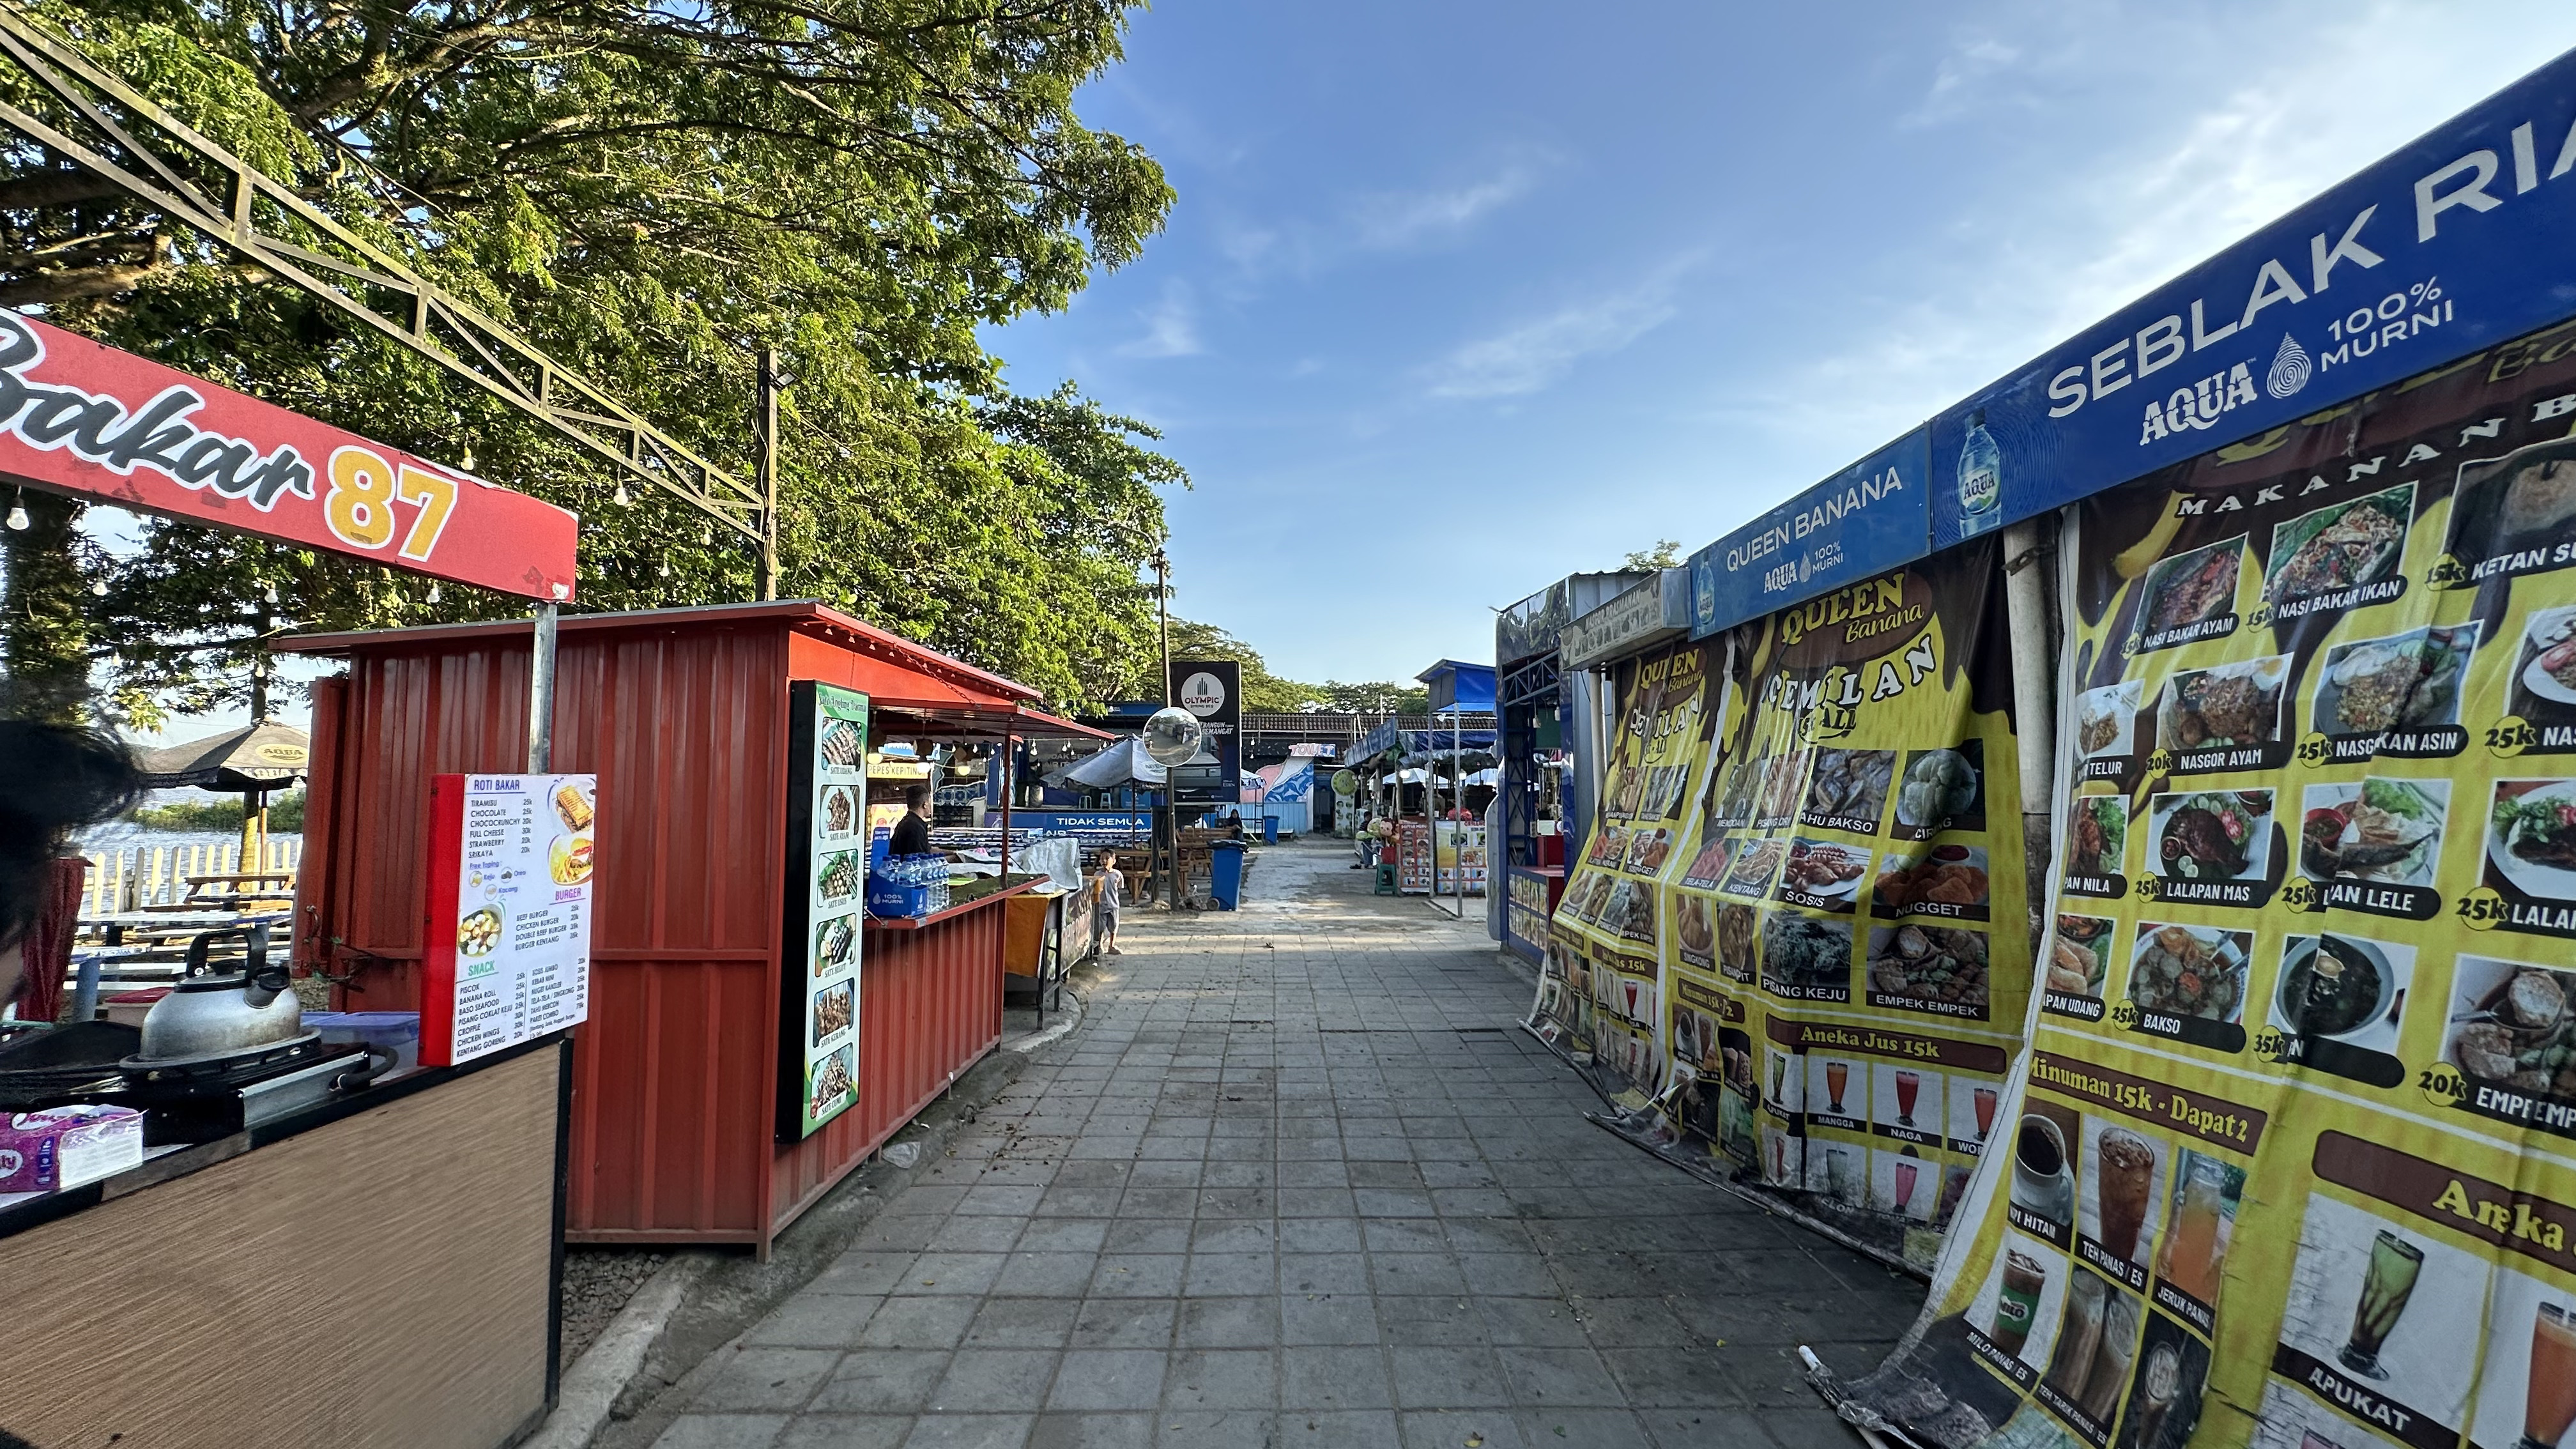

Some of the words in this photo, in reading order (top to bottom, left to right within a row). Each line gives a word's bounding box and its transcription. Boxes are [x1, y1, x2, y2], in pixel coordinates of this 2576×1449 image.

[2047, 203, 2385, 418] SEBLAK
[2414, 117, 2576, 243] RI
[2327, 275, 2442, 342] 100%
[2321, 300, 2454, 372] MURNI
[2139, 362, 2258, 446] AQUA
[2177, 417, 2506, 516] MAKANAN
[1963, 471, 1995, 500] AQUA
[324, 445, 459, 562] 87
[1727, 521, 1790, 572] QUEEN
[1795, 466, 1903, 540] BANANA
[1814, 541, 1841, 561] 100%
[1812, 554, 1843, 574] MURNI
[2426, 563, 2465, 583] 15k
[2471, 548, 2547, 580] KETAN
[1763, 560, 1798, 594] AQUA
[1698, 597, 1714, 612] AQUA
[1781, 573, 1905, 644] QUEEN
[2247, 609, 2274, 626] 15k
[2279, 602, 2308, 619] NASI
[2312, 588, 2359, 611] BAKAR
[2361, 580, 2400, 601] IKAN
[1846, 602, 1924, 643] Banana
[2143, 632, 2166, 648] NASI
[2166, 626, 2200, 645] BAKAR
[2200, 617, 2234, 637] AYAM
[2297, 739, 2333, 760] 25k
[2419, 733, 2457, 752] ASIN
[2485, 724, 2536, 749] 25k
[1288, 744, 1334, 756] TOILET
[2146, 755, 2172, 771] 20k
[2181, 753, 2224, 770] NASGOR
[2229, 748, 2262, 766] AYAM
[868, 765, 889, 775] PEPES
[2089, 761, 2122, 775] TELUR
[474, 779, 492, 790] ROTI
[495, 779, 520, 790] BAKAR
[470, 818, 521, 827] CHOCOCRUNCHY
[1800, 812, 1824, 826] AHU
[1827, 817, 1873, 832] BAKSO
[469, 839, 505, 848] STRAWBERRY
[555, 887, 581, 900] BURGER
[1728, 884, 1761, 895] KENTANG
[2083, 878, 2110, 893] NILA
[2135, 879, 2161, 895] 25k
[2166, 884, 2220, 900] LALAPAN
[2224, 886, 2250, 901] MAS
[1785, 891, 1825, 907] SOSIS
[1896, 902, 1963, 917] NUGGET
[2282, 886, 2317, 905] 25k
[2366, 888, 2414, 912] LELE
[2457, 898, 2509, 921] 25k
[516, 921, 539, 931] CHICKEN
[540, 917, 559, 927] BURGER
[529, 910, 548, 919] BURGER
[515, 940, 535, 951] BURGER
[536, 935, 560, 947] KENTANG
[516, 931, 535, 941] DOUBLE
[548, 924, 567, 935] BURGER
[468, 960, 494, 977] SNACK
[1683, 953, 1710, 969] SINGKONG
[459, 993, 482, 1005] BANANA
[484, 989, 496, 999] ROLL
[460, 983, 480, 995] PISCOK
[1763, 979, 1801, 997] PISANG
[1806, 988, 1846, 1001] KEJU
[458, 1015, 479, 1026] PISANG
[480, 1007, 500, 1020] COKLAT
[501, 1004, 512, 1013] KEJU
[459, 1005, 473, 1016] BASO
[475, 999, 500, 1011] SEAFOOD
[1876, 995, 1924, 1009] EMPEK
[1928, 1001, 1978, 1017] EMPEK
[2068, 999, 2101, 1016] UDANG
[457, 1023, 481, 1036] CROFFLE
[2112, 1007, 2138, 1023] 25k
[2143, 1014, 2180, 1034] BAKSO
[457, 1033, 482, 1046] CHICKEN
[483, 1027, 500, 1039] WINGS
[457, 1043, 482, 1057] KENTANG
[483, 1036, 506, 1048] GORENG
[1801, 1026, 1859, 1046] Aneka
[1864, 1032, 1897, 1052] Jus
[1901, 1041, 1941, 1058] 15k
[2253, 1034, 2284, 1053] 35k
[2418, 1071, 2467, 1100] 20k
[1818, 1116, 1854, 1129] MANGGA
[2114, 1082, 2152, 1112] 15k
[2170, 1095, 2234, 1137] Dapat
[2237, 1121, 2248, 1143] 2
[1890, 1128, 1922, 1142] NAGA
[2023, 1213, 2056, 1239] HITAM
[2083, 1241, 2099, 1262] TEH
[2099, 1252, 2124, 1277] PANAS
[2131, 1268, 2143, 1287] ES
[2158, 1286, 2186, 1313] JERUK
[1966, 1332, 1991, 1353] MILO
[1988, 1349, 2014, 1371] PANAS
[2016, 1367, 2028, 1381] ES
[2309, 1365, 2412, 1432] APUKAT
[2097, 1430, 2107, 1445] ES
